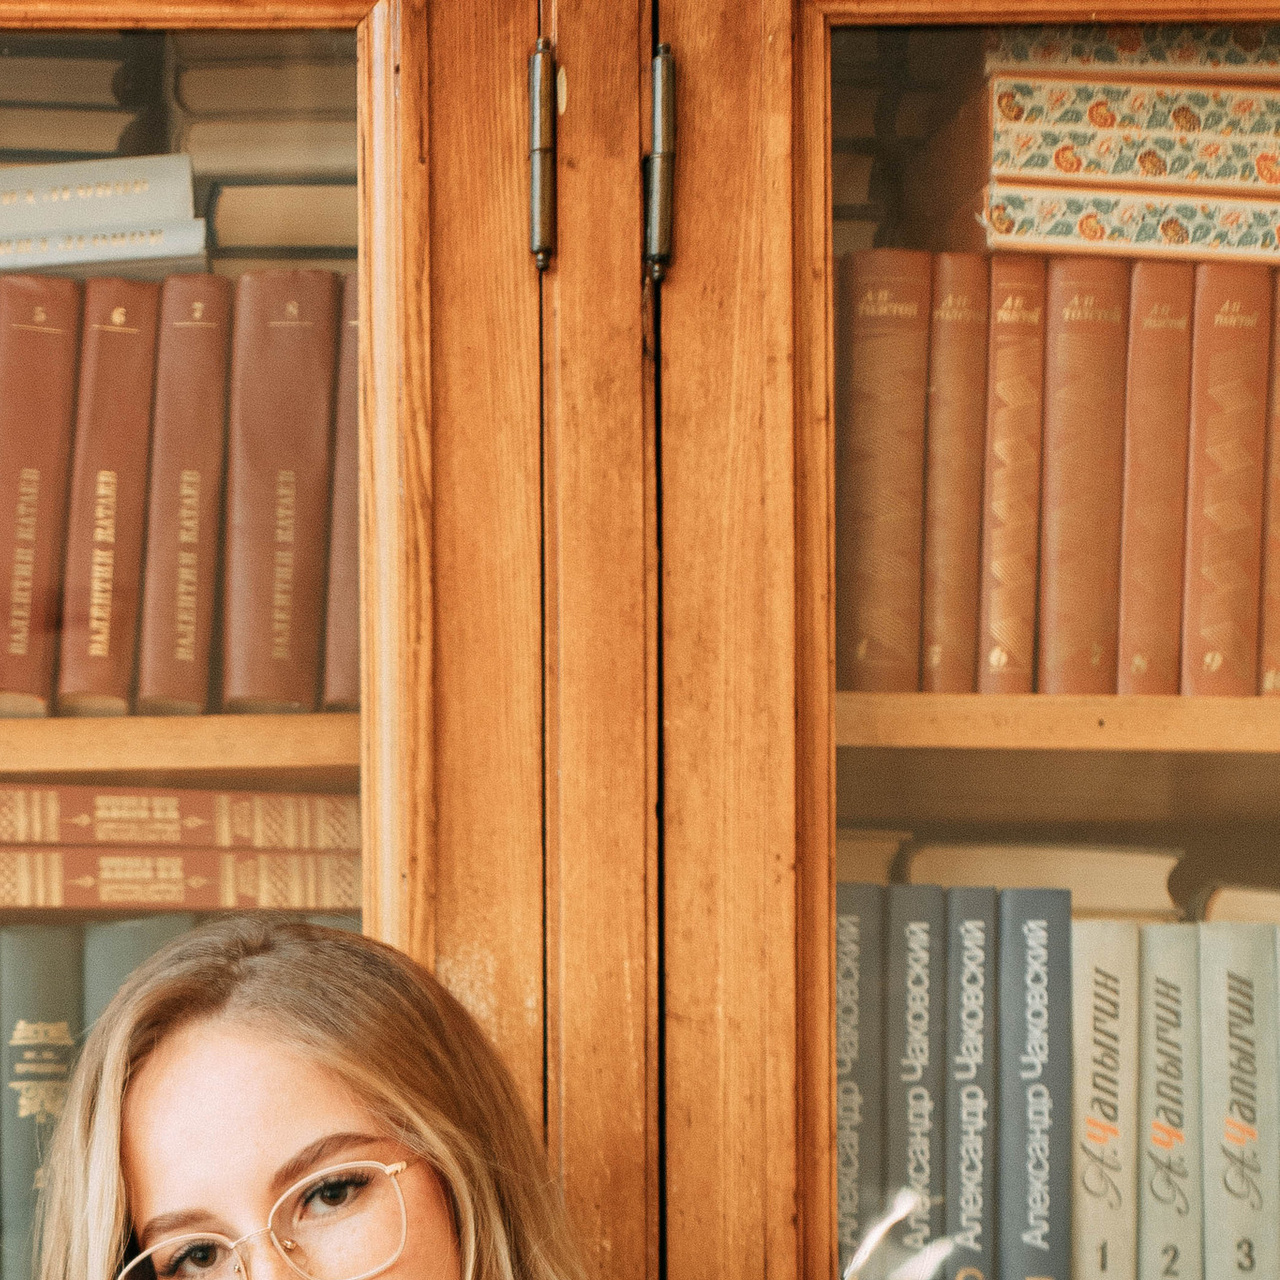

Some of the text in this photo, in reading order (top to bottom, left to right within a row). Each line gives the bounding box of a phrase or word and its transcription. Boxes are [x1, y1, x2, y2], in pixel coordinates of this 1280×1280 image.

[953, 920, 989, 1251] Александр Чаковский
[1020, 919, 1053, 1250] Александр Чаковский
[1087, 967, 1120, 1145] Чапыгин
[1152, 976, 1184, 1150] Чапыгин
[1224, 970, 1258, 1147] Чапыгин
[1098, 1242, 1109, 1271] 1
[1162, 1245, 1180, 1276] 2
[1237, 1241, 1256, 1271] 3
